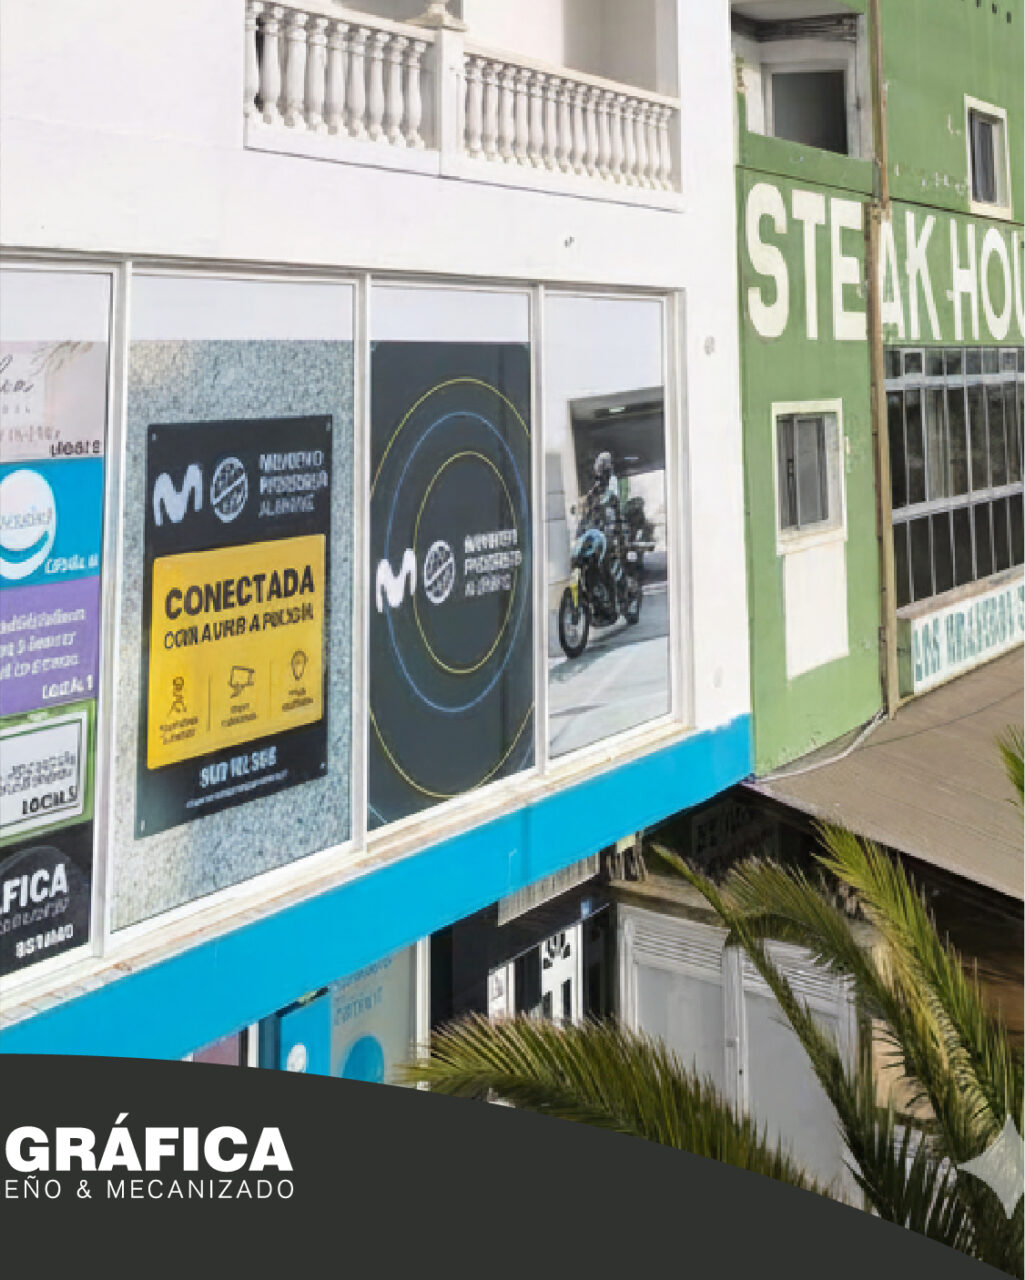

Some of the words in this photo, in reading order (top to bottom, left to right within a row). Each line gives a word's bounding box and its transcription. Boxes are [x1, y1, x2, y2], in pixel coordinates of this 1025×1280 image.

[745, 182, 942, 341] STEAK
[165, 565, 315, 621] CONECTADA
[0, 863, 69, 915] FICA
